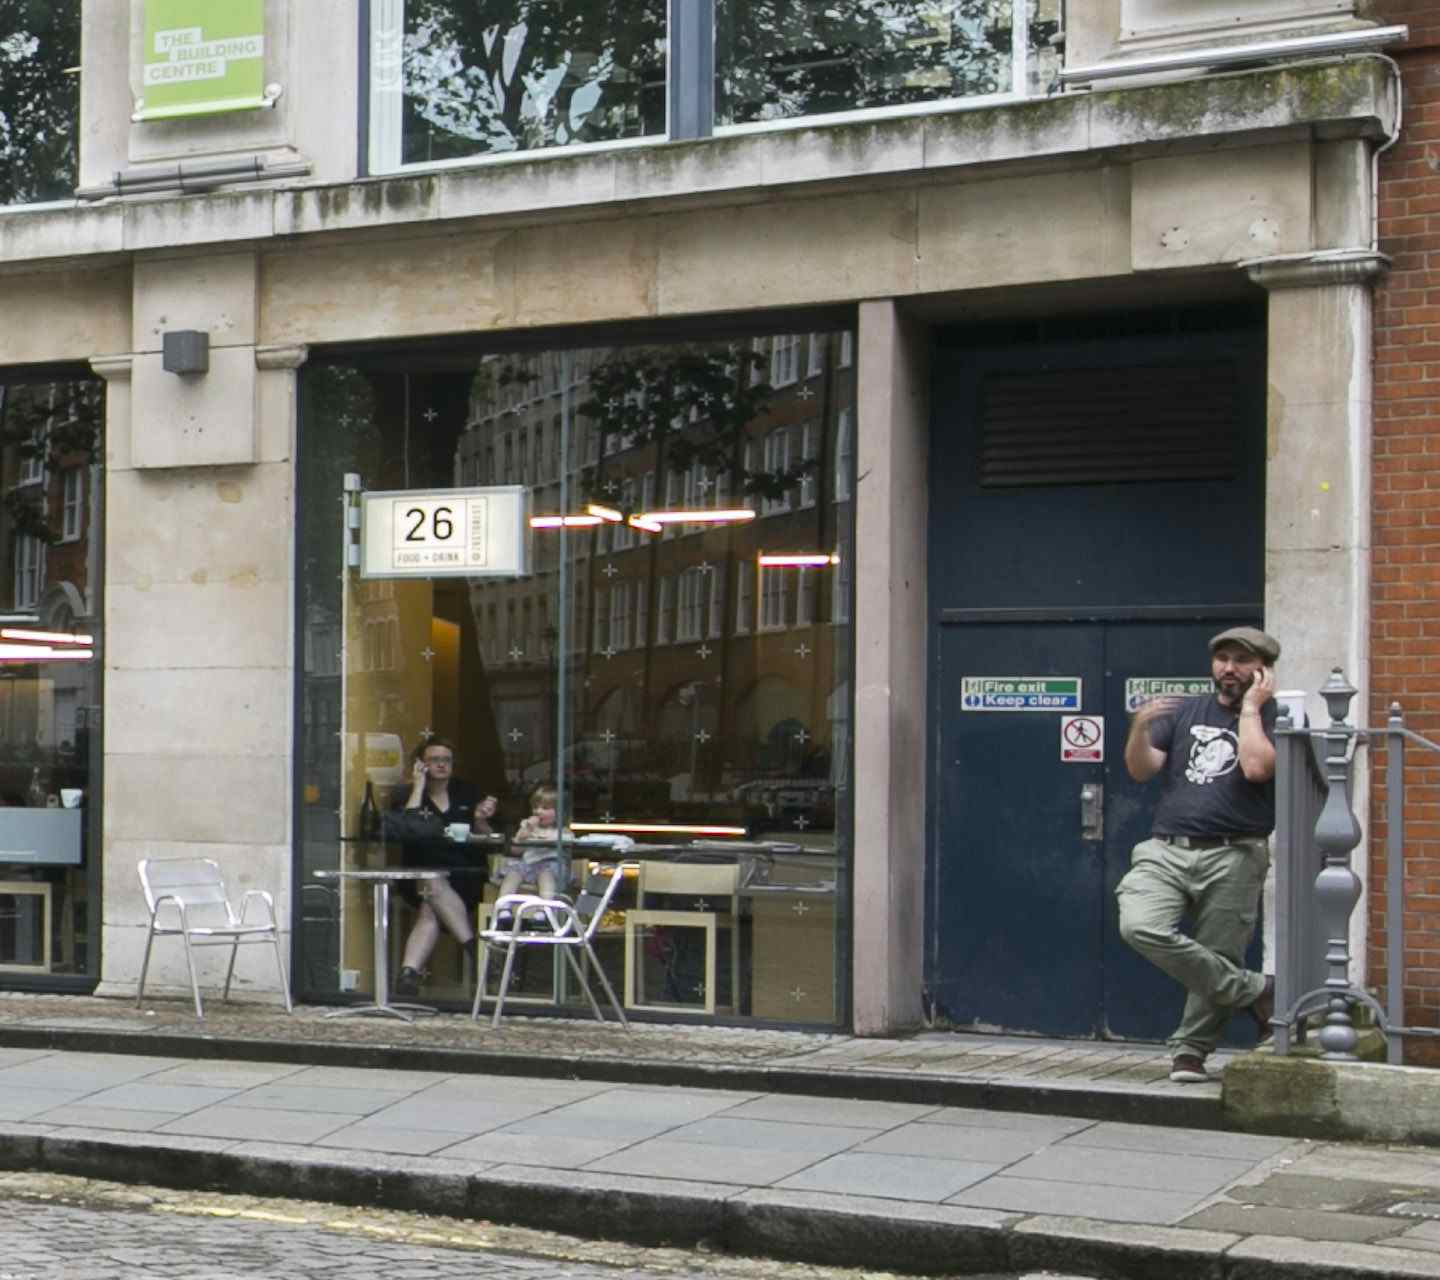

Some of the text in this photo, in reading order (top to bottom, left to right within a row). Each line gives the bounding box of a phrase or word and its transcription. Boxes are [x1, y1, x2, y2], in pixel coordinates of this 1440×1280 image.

[160, 31, 193, 49] THE
[176, 39, 257, 61] BUILDING
[149, 62, 217, 80] CENTRE
[405, 506, 454, 542] 26
[397, 552, 421, 563] FOOD
[432, 551, 460, 562] DRINK
[984, 681, 1047, 693] Fire exit
[1151, 681, 1189, 693] Fire
[985, 695, 1068, 708] Keep clear
